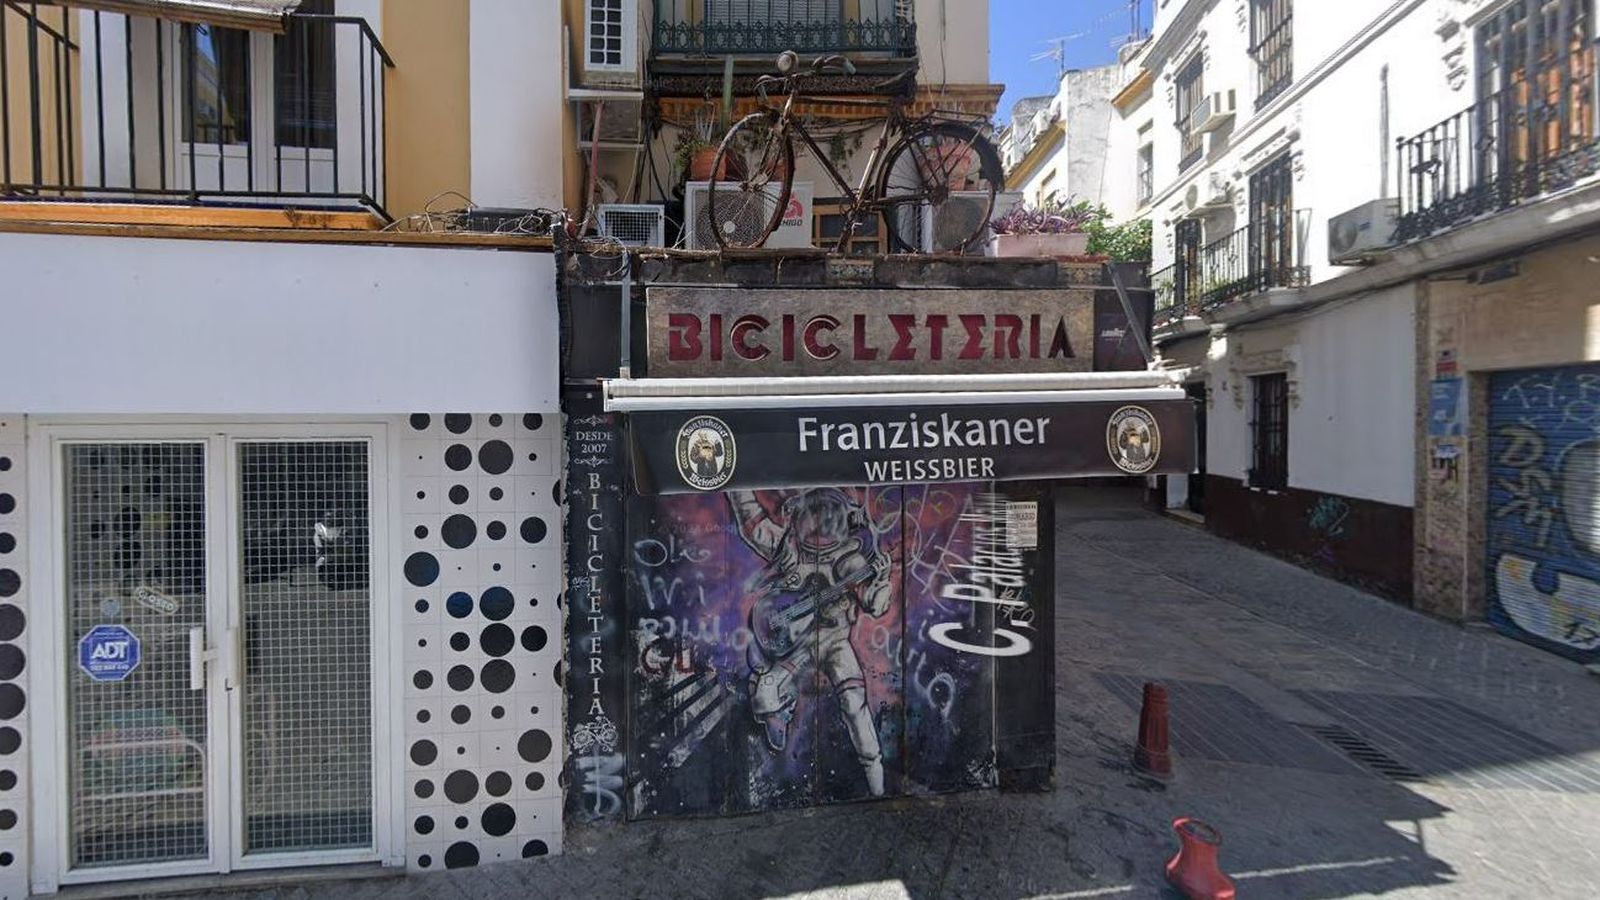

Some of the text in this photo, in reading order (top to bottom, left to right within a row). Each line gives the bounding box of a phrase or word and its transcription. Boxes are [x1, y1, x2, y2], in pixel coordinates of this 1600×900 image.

[668, 313, 1076, 362] BICICLETERIA
[576, 430, 613, 442] DESDE
[798, 412, 1051, 452] Franziskaner
[581, 443, 608, 454] 2007
[864, 457, 996, 482] WEISSBIER
[587, 472, 605, 715] BICICLETERIA
[91, 641, 129, 659] ADT
